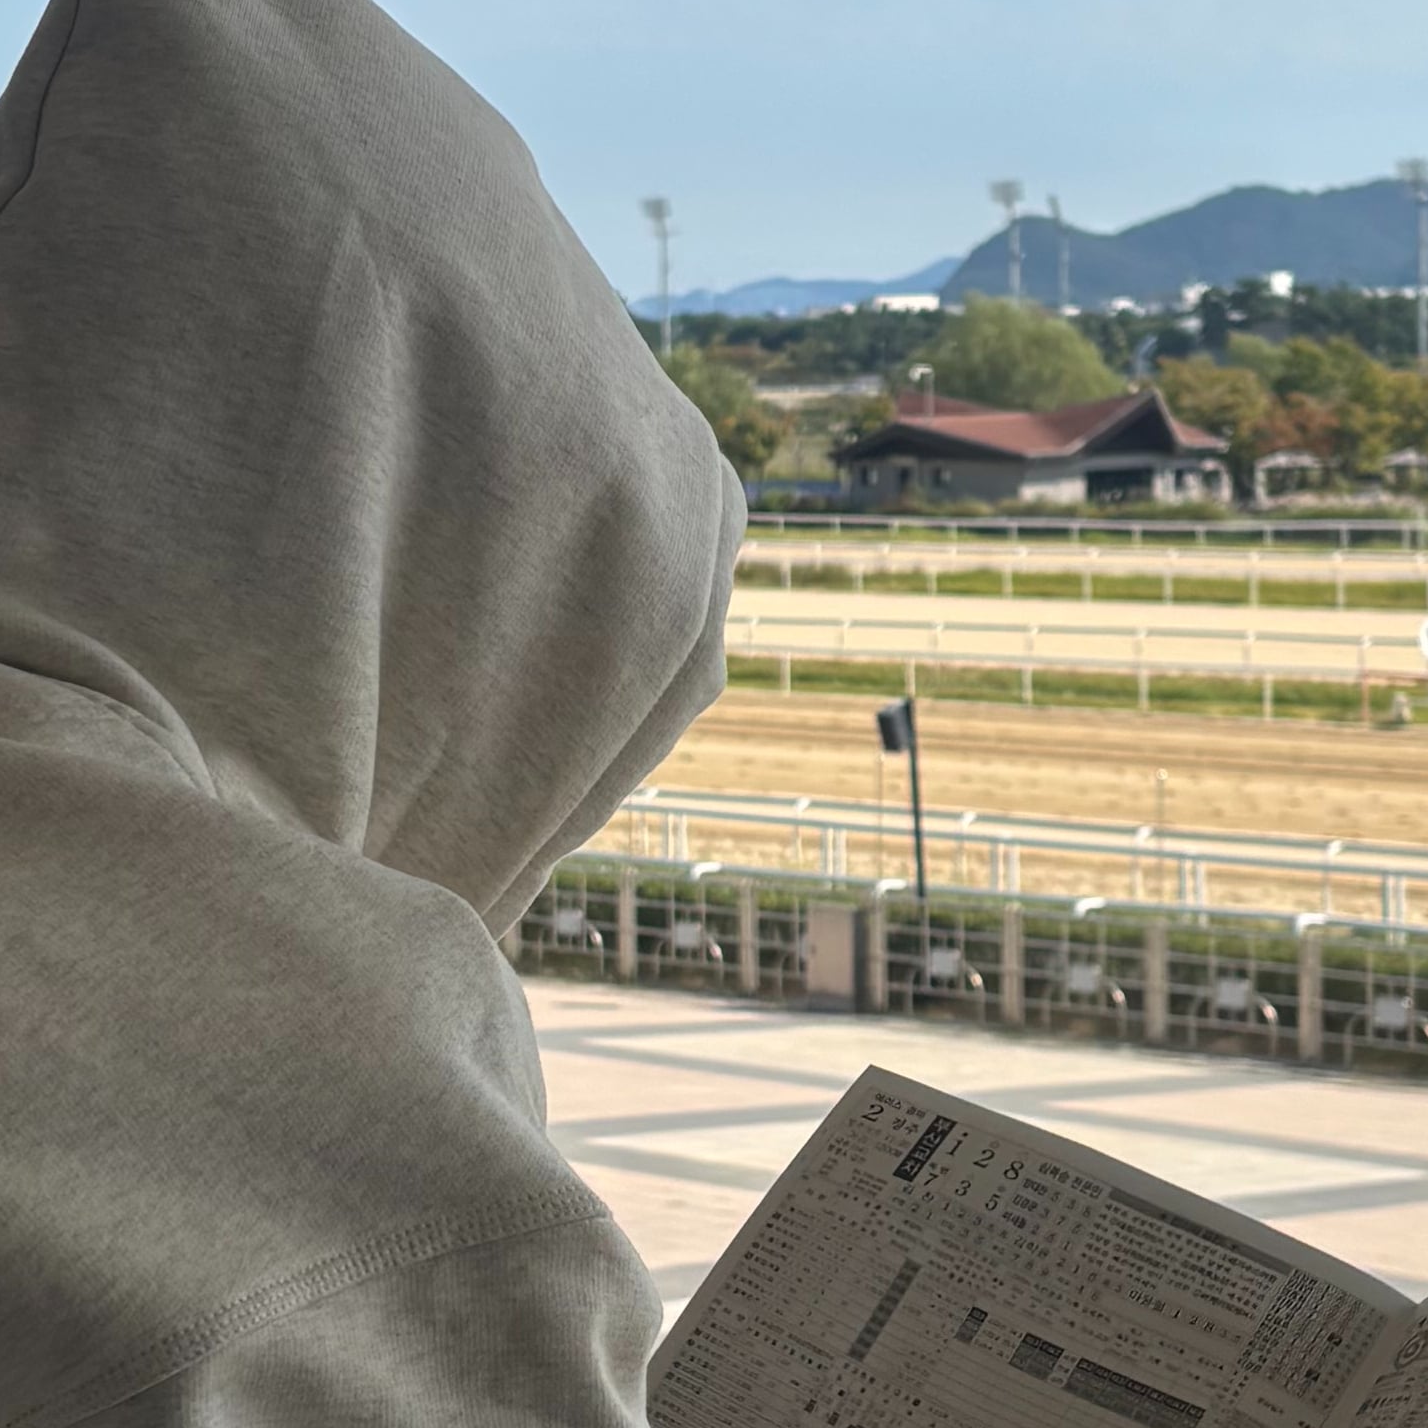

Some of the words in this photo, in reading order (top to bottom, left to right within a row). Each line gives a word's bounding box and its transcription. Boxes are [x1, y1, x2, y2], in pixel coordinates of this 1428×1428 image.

[860, 1103, 885, 1122] 2
[973, 1148, 996, 1168] 2
[1003, 1160, 1024, 1180] 8
[955, 1179, 971, 1196] 3
[985, 1193, 1001, 1211] 5
